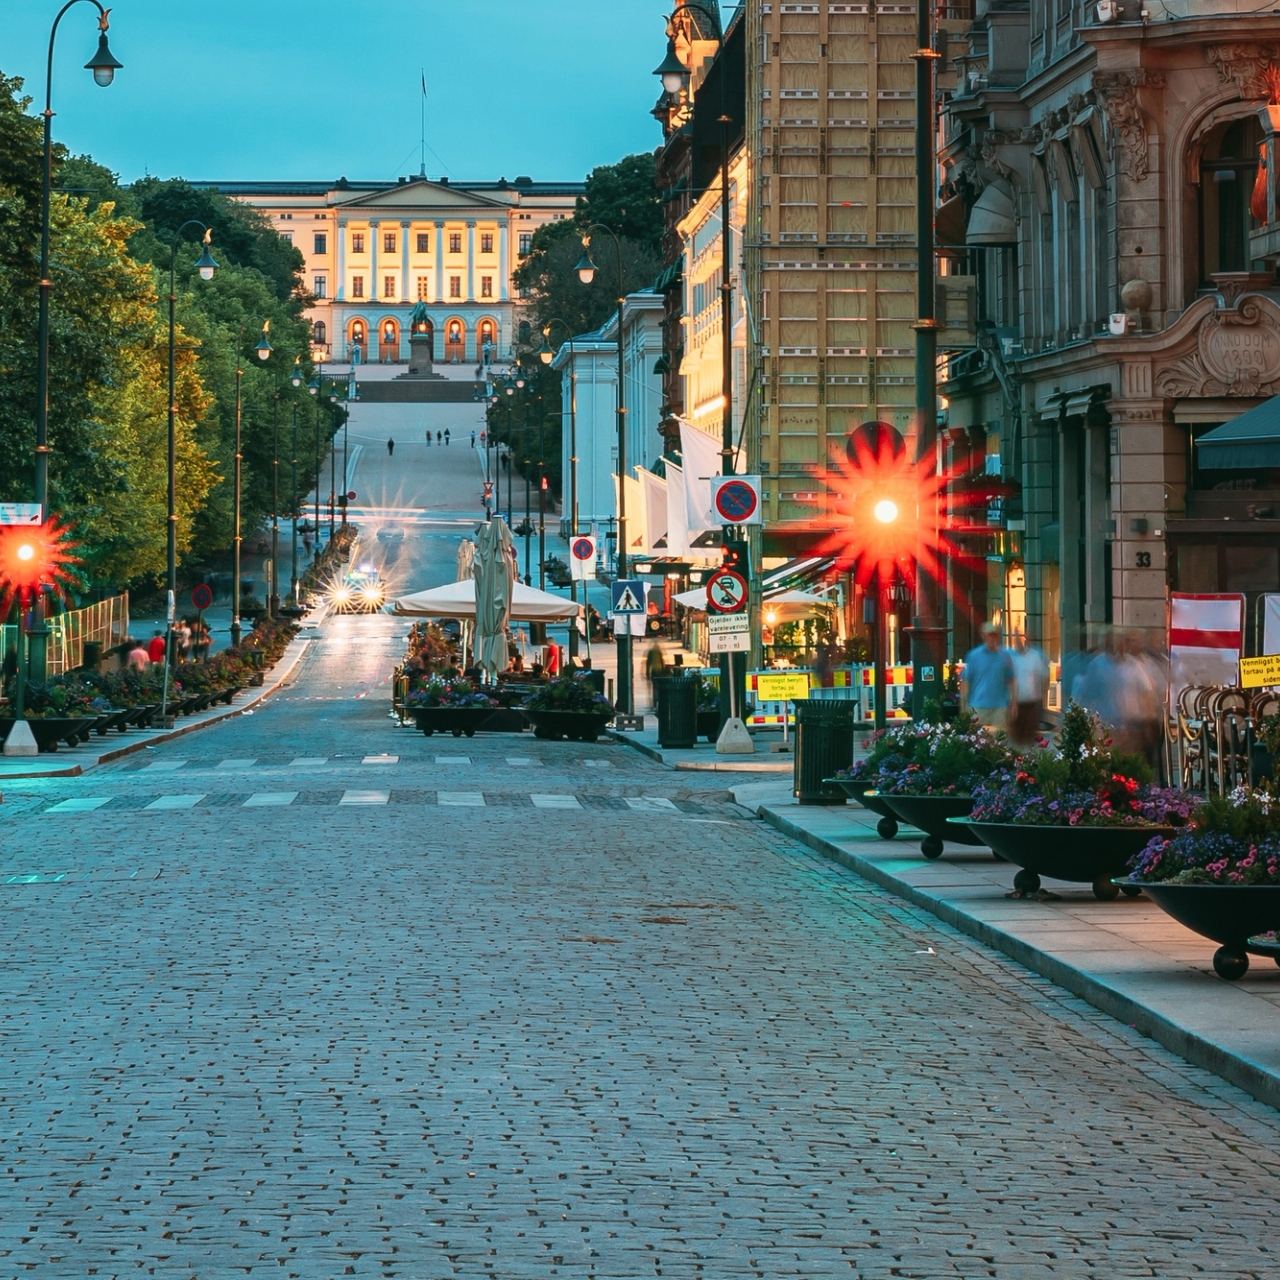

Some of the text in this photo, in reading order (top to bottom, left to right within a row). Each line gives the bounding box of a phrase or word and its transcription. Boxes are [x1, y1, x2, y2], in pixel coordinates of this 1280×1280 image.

[1215, 334, 1240, 348] ANNO
[1136, 551, 1151, 568] 33
[710, 617, 732, 625] Gjelder
[1242, 658, 1274, 667] Vennligst
[1243, 667, 1264, 675] fortau
[1266, 665, 1275, 674] på
